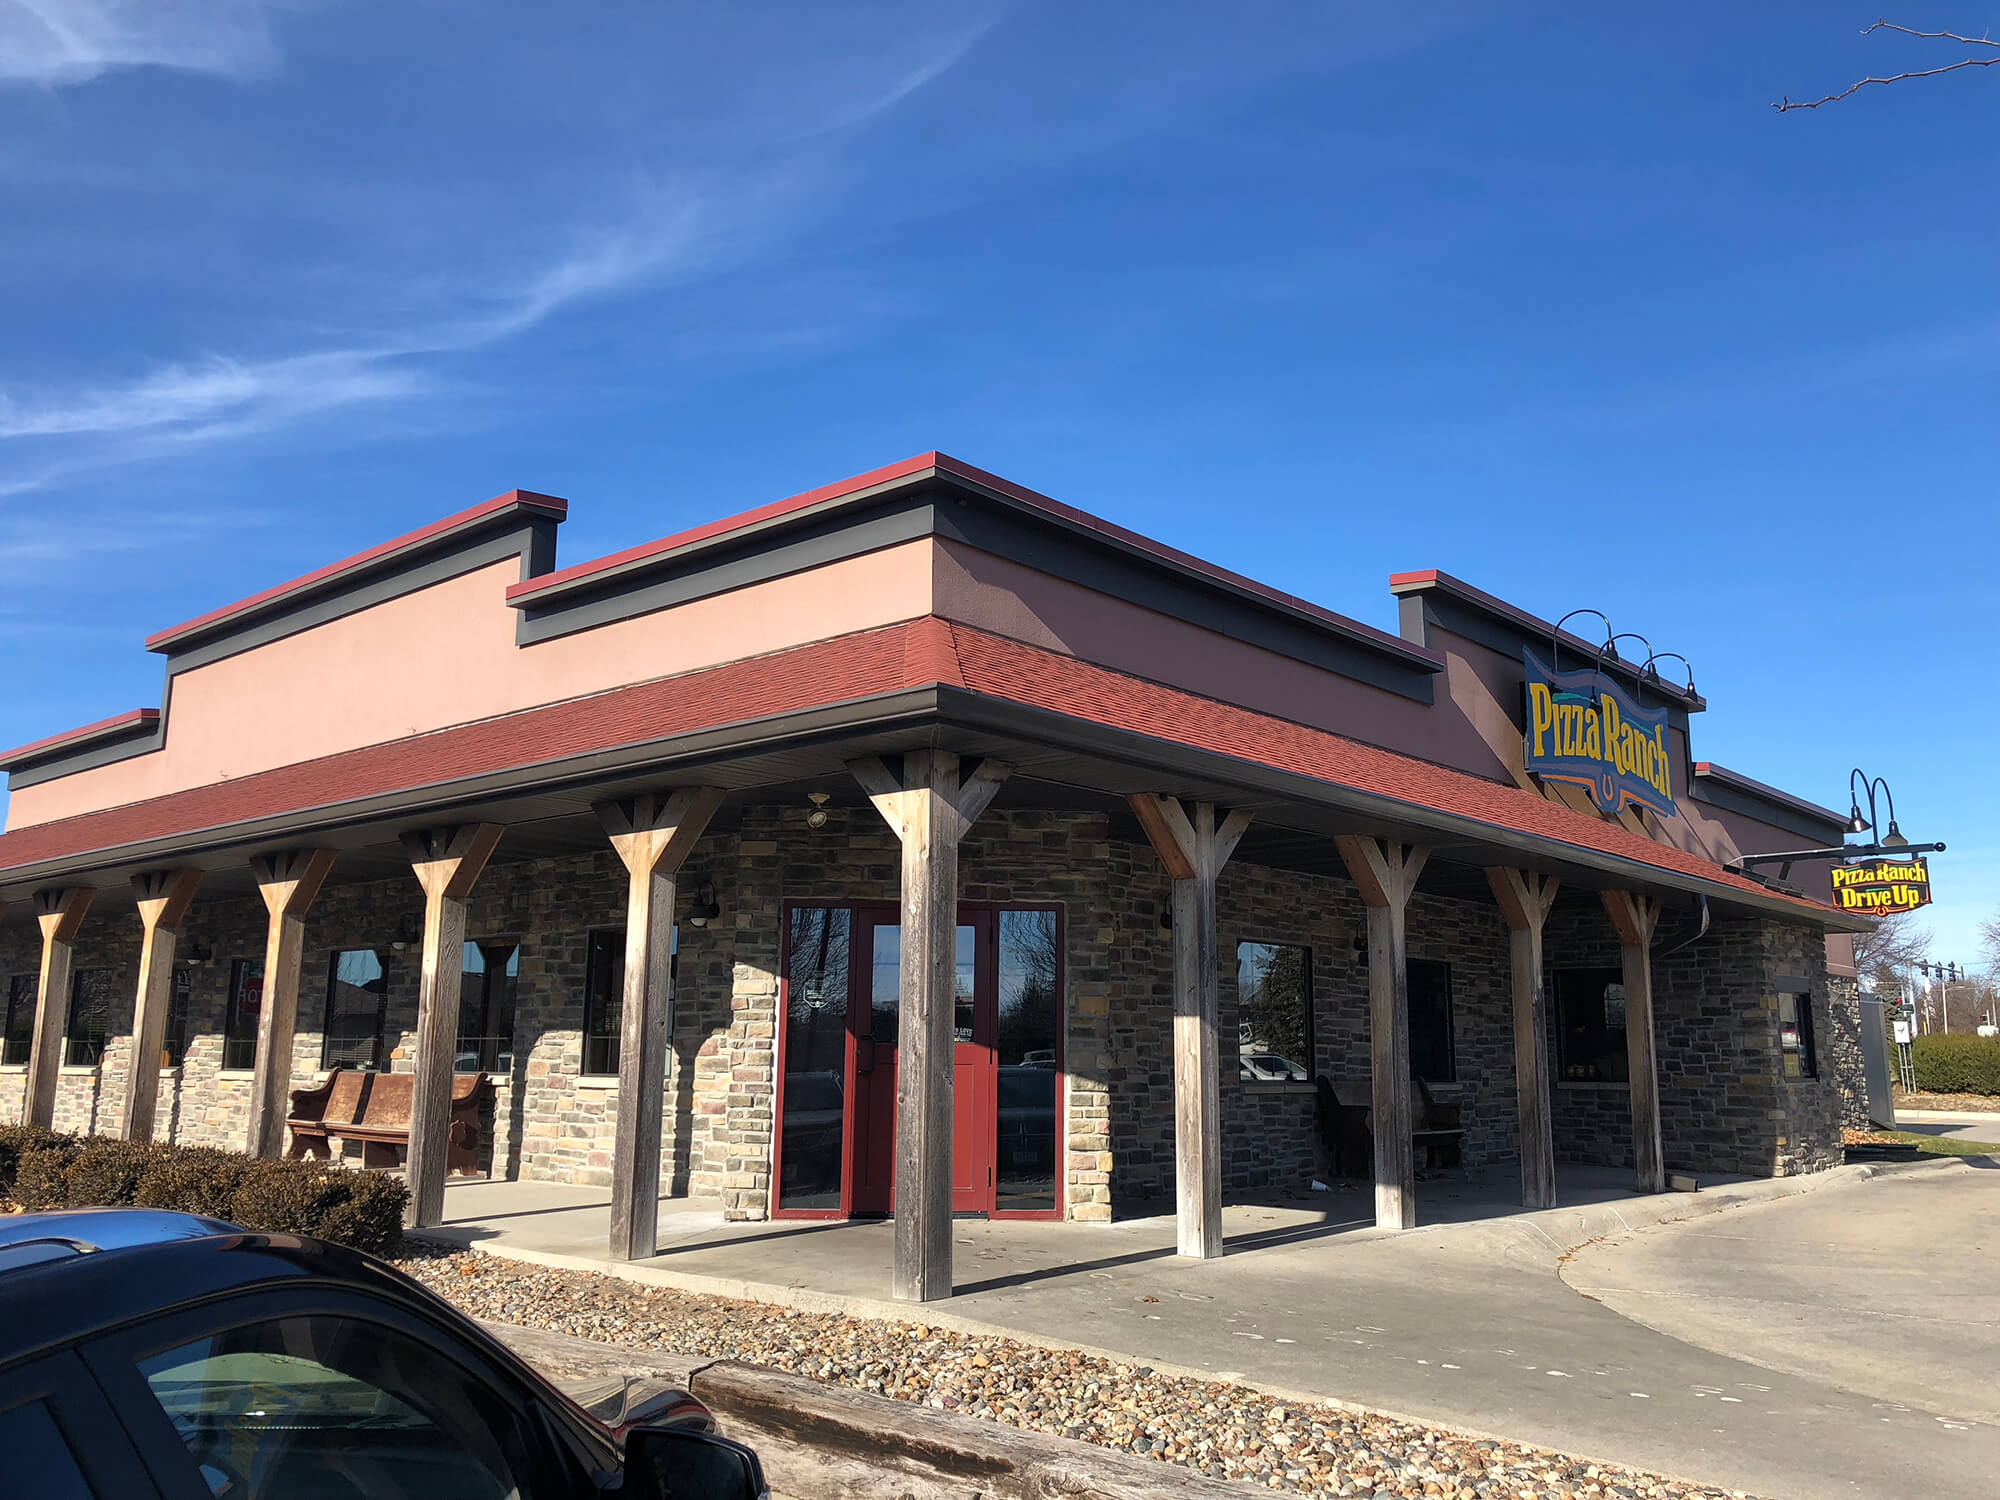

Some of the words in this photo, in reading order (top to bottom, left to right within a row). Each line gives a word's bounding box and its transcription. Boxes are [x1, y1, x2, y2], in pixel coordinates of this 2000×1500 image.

[1531, 683, 1601, 760] Pizza
[1601, 694, 1672, 800] Ranch
[1831, 868, 1876, 888] Pizza
[1876, 862, 1927, 882] Ranch
[1841, 887, 1892, 908] Drive
[1892, 884, 1920, 909] Up
